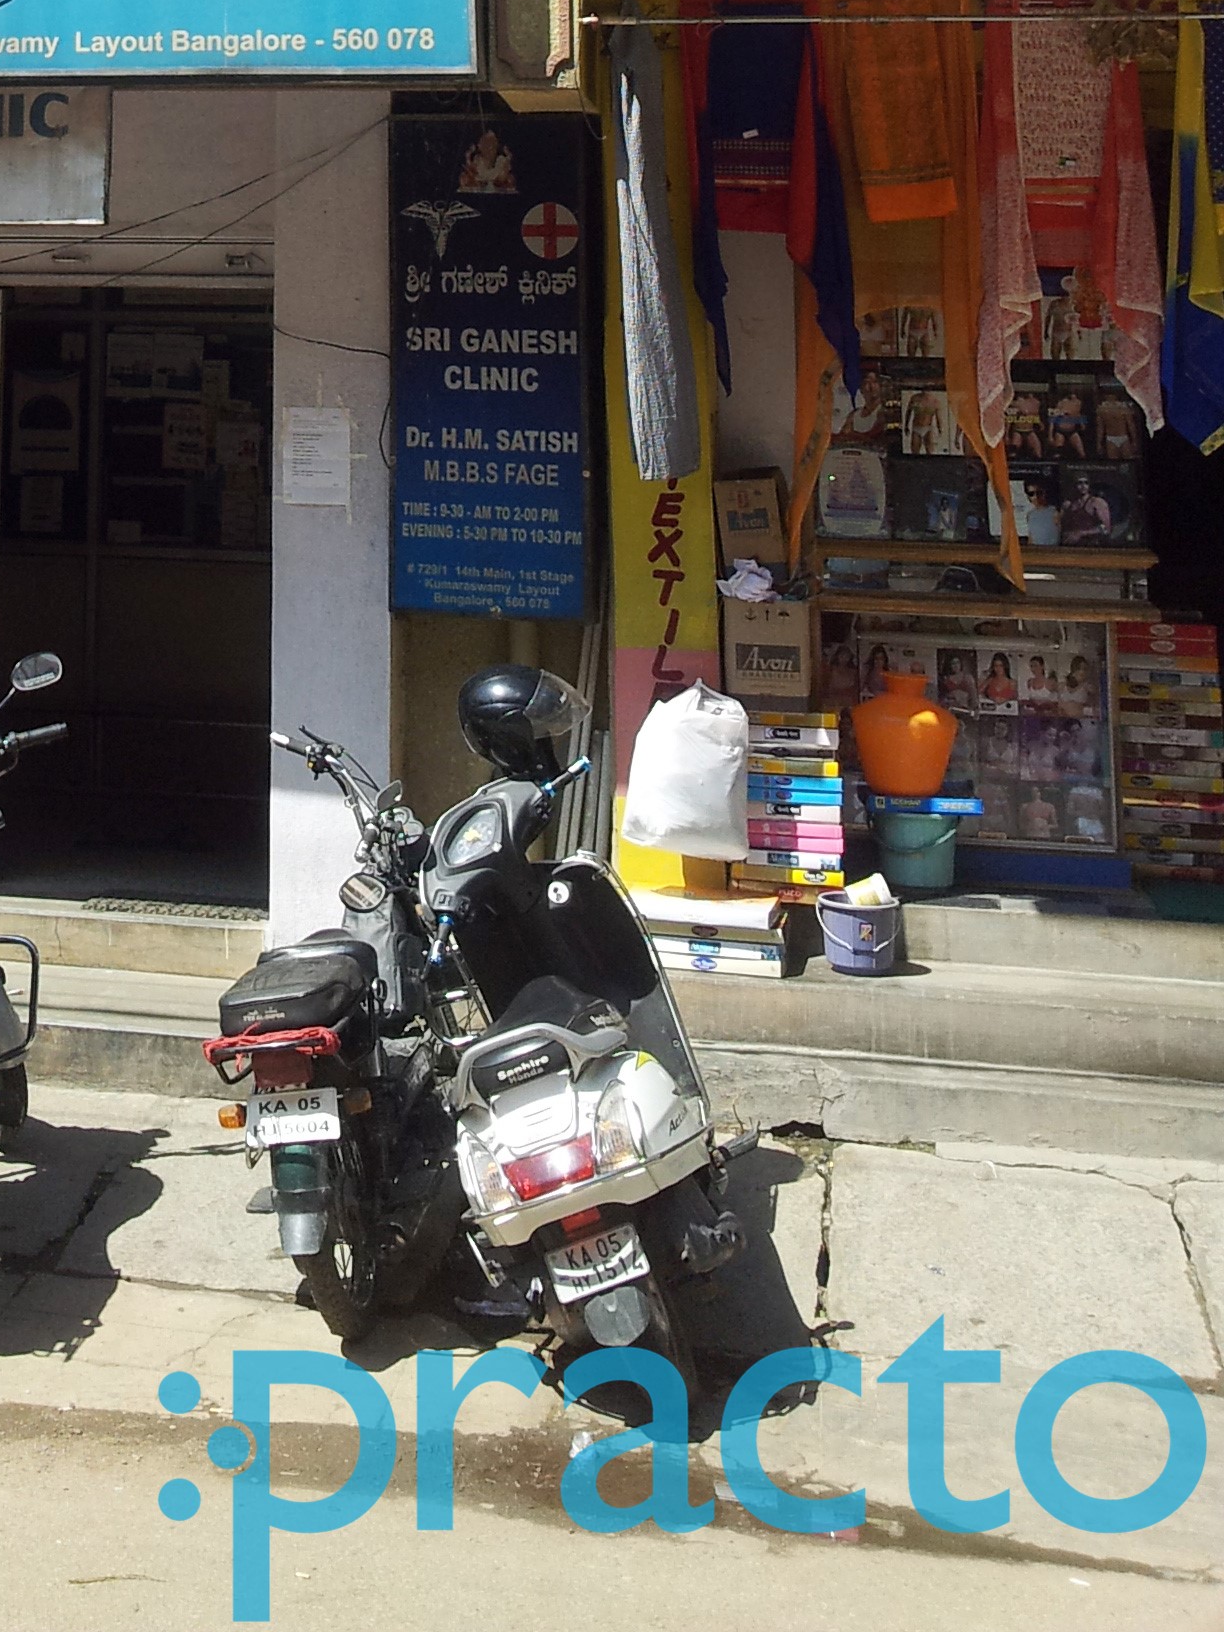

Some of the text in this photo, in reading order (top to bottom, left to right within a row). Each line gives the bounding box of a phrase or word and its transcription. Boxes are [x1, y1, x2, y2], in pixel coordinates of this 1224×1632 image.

[75, 31, 163, 58] Layout
[172, 30, 306, 57] Bangalore
[332, 29, 378, 50] 560
[388, 28, 435, 50] 078
[406, 327, 577, 354] SRI GANESH
[444, 365, 539, 392] CLINIC
[406, 426, 578, 453] Dr. H.M. SATISH
[424, 460, 559, 486] M.B.B.S FAGE
[402, 502, 559, 523] TIME 9-30 AM TO 2-00 PM
[402, 523, 582, 545] EVENING 5-30 PM TO 10-30 PM
[425, 579, 560, 597] Kumaraswamy Layout
[540, 570, 574, 584] Stage
[433, 593, 494, 607] Bangalore
[647, 478, 687, 702] EXTIL
[743, 646, 793, 671] Avon
[509, 1067, 544, 1085] Honda
[259, 1097, 321, 1115] KA 05
[285, 1121, 330, 1134] 5604
[565, 1233, 622, 1269] KA 05
